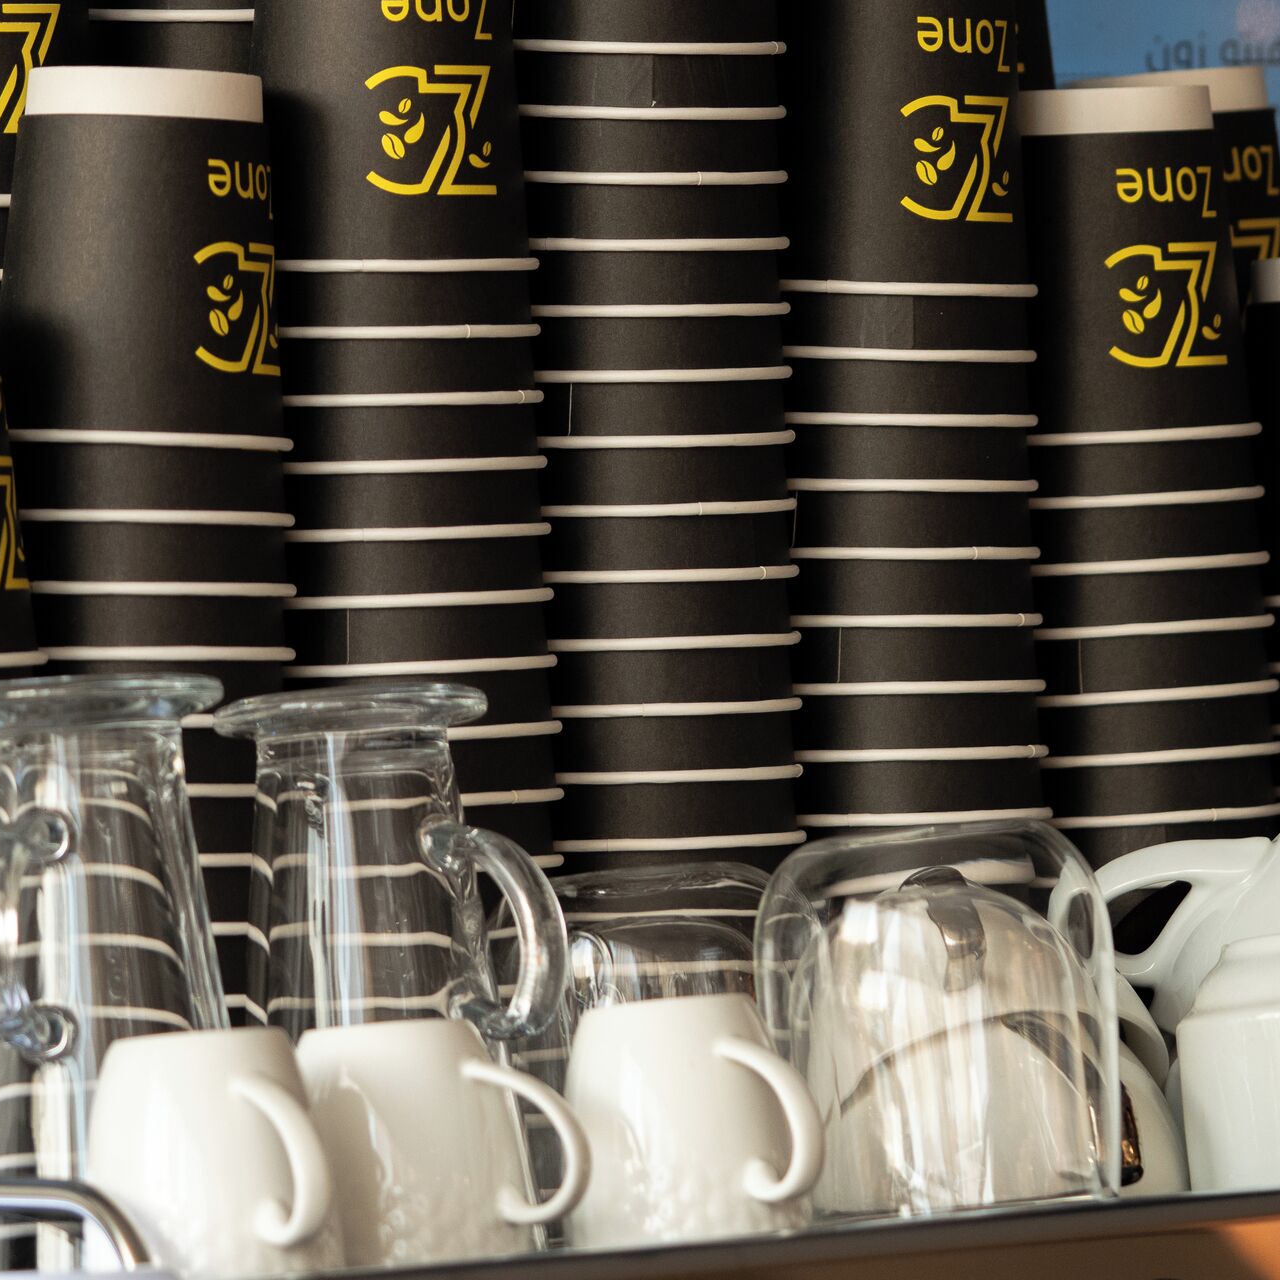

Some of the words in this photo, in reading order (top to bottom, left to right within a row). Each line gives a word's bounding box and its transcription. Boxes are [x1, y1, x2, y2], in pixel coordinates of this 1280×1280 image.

[916, 16, 1011, 73] Zone
[207, 158, 273, 220] one
[1114, 166, 1216, 218] Zone
